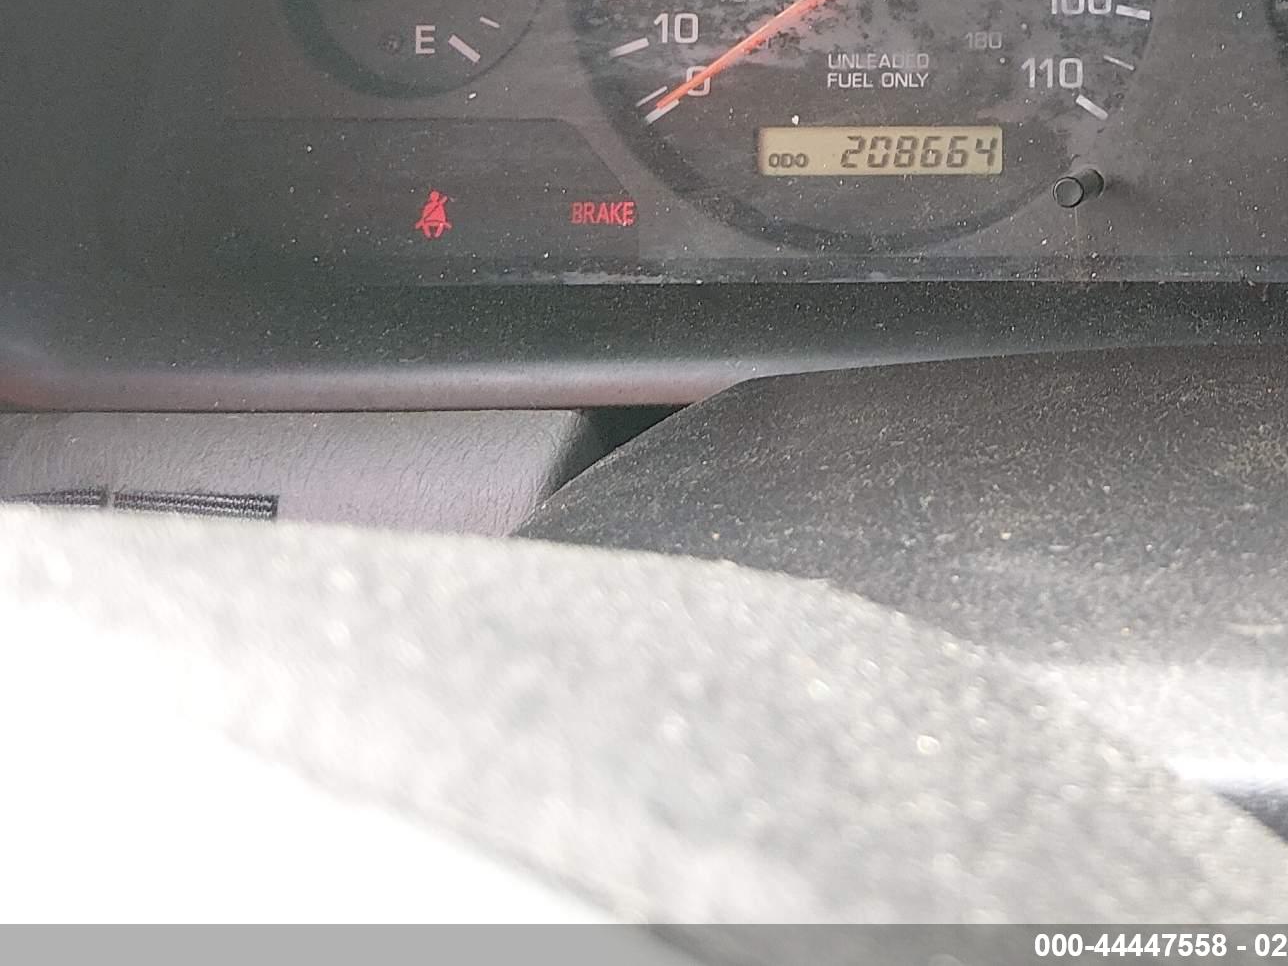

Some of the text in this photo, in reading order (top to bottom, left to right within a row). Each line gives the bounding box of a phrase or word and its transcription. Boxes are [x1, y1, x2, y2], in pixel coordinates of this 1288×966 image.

[415, 26, 436, 54] E
[654, 12, 699, 43] 10
[828, 52, 930, 70] UNLEADED
[1021, 57, 1083, 89] 110
[686, 67, 711, 96] 0
[827, 72, 930, 89] FUEL ONLY
[768, 136, 998, 169] ODO 208664
[570, 201, 636, 226] BRAKE
